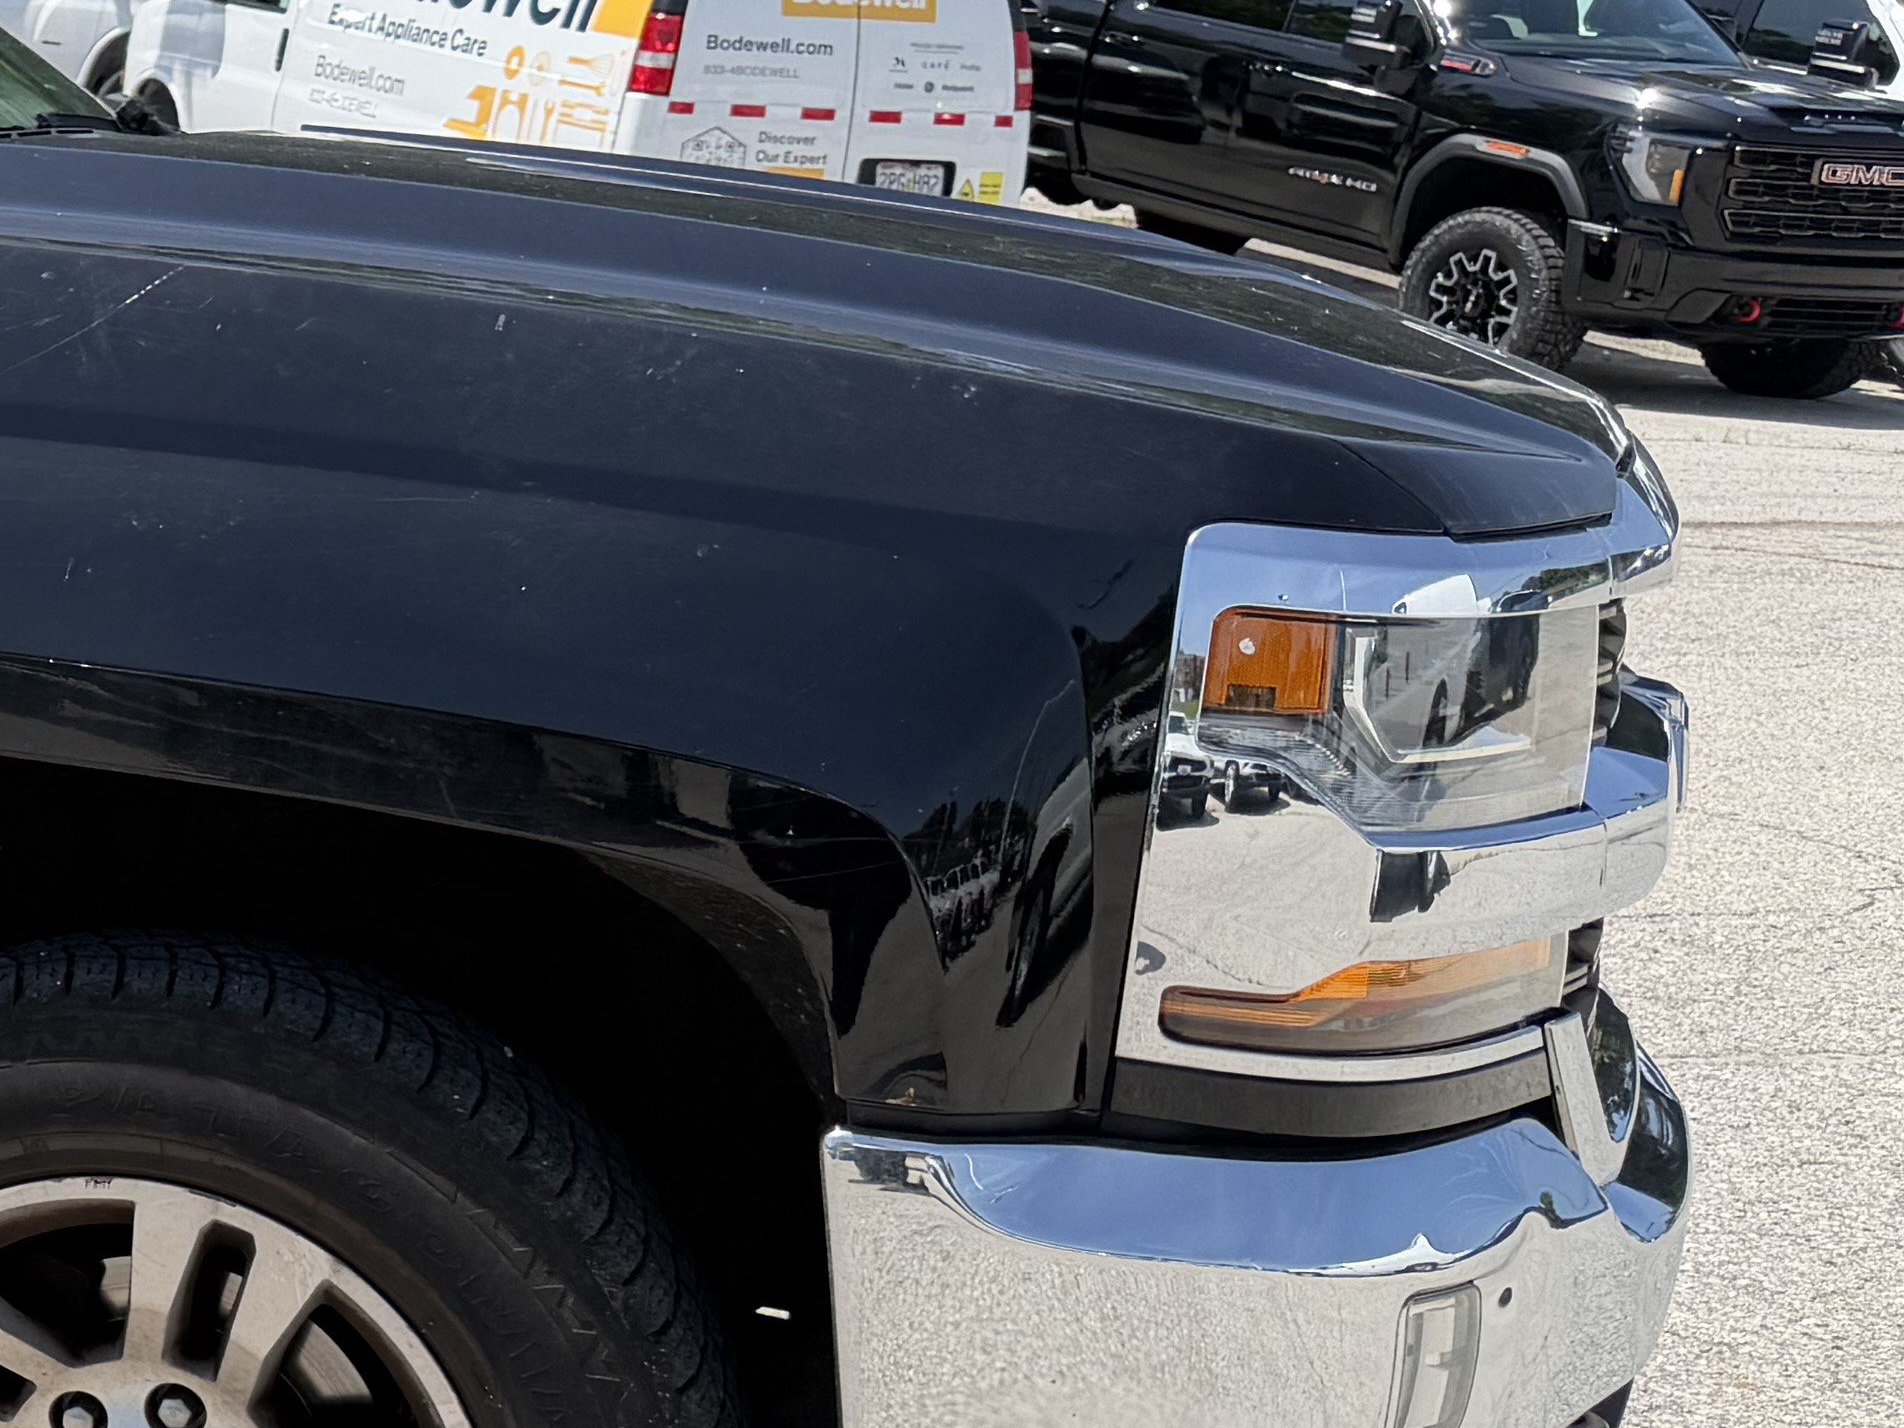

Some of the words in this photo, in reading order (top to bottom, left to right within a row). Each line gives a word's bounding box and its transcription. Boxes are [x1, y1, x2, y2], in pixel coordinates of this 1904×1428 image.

[375, 13, 448, 49] Appliance
[450, 28, 488, 58] Care
[705, 34, 833, 56] Bodewell.com
[314, 53, 405, 97] Bodewell.com
[758, 130, 817, 146] Discover
[755, 149, 779, 164] Our
[783, 150, 828, 168] Expert
[1820, 163, 1904, 187] GMC
